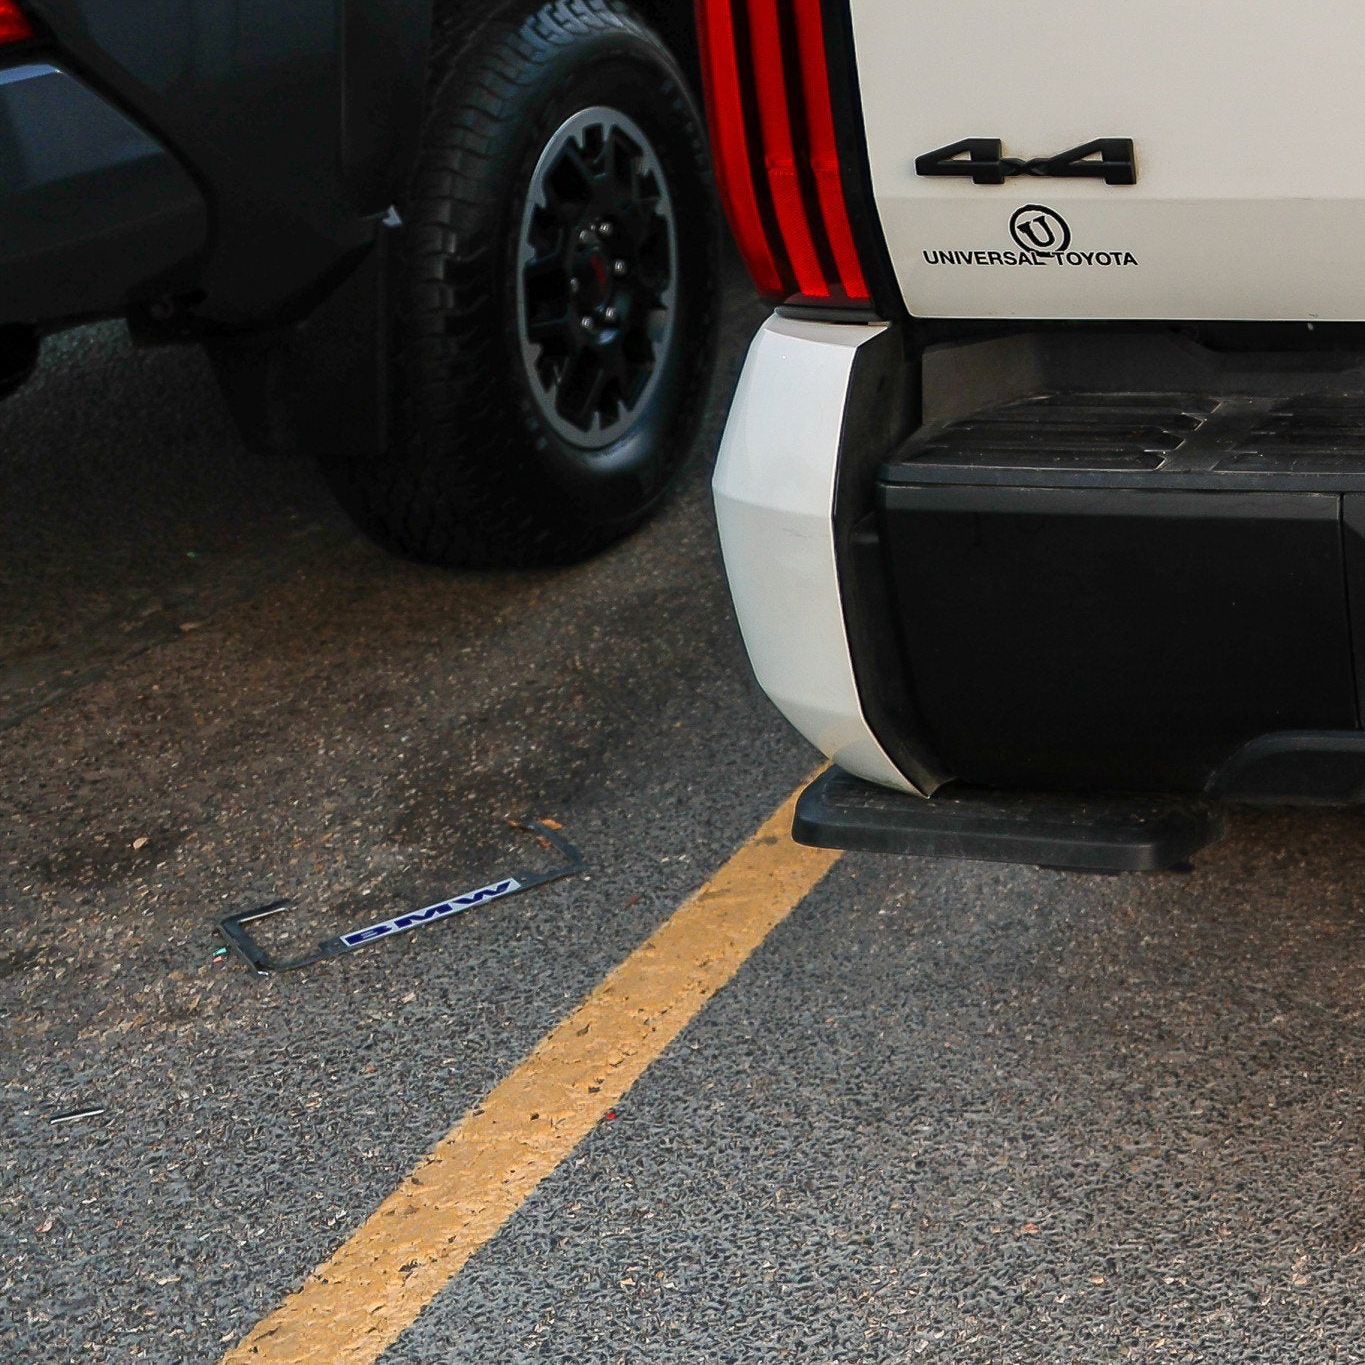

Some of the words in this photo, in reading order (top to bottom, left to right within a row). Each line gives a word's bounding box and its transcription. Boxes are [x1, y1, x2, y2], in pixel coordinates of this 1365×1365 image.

[923, 251, 1047, 266] UNIVERSAL
[1050, 251, 1139, 266] TOYOTA
[344, 881, 512, 946] BMW
